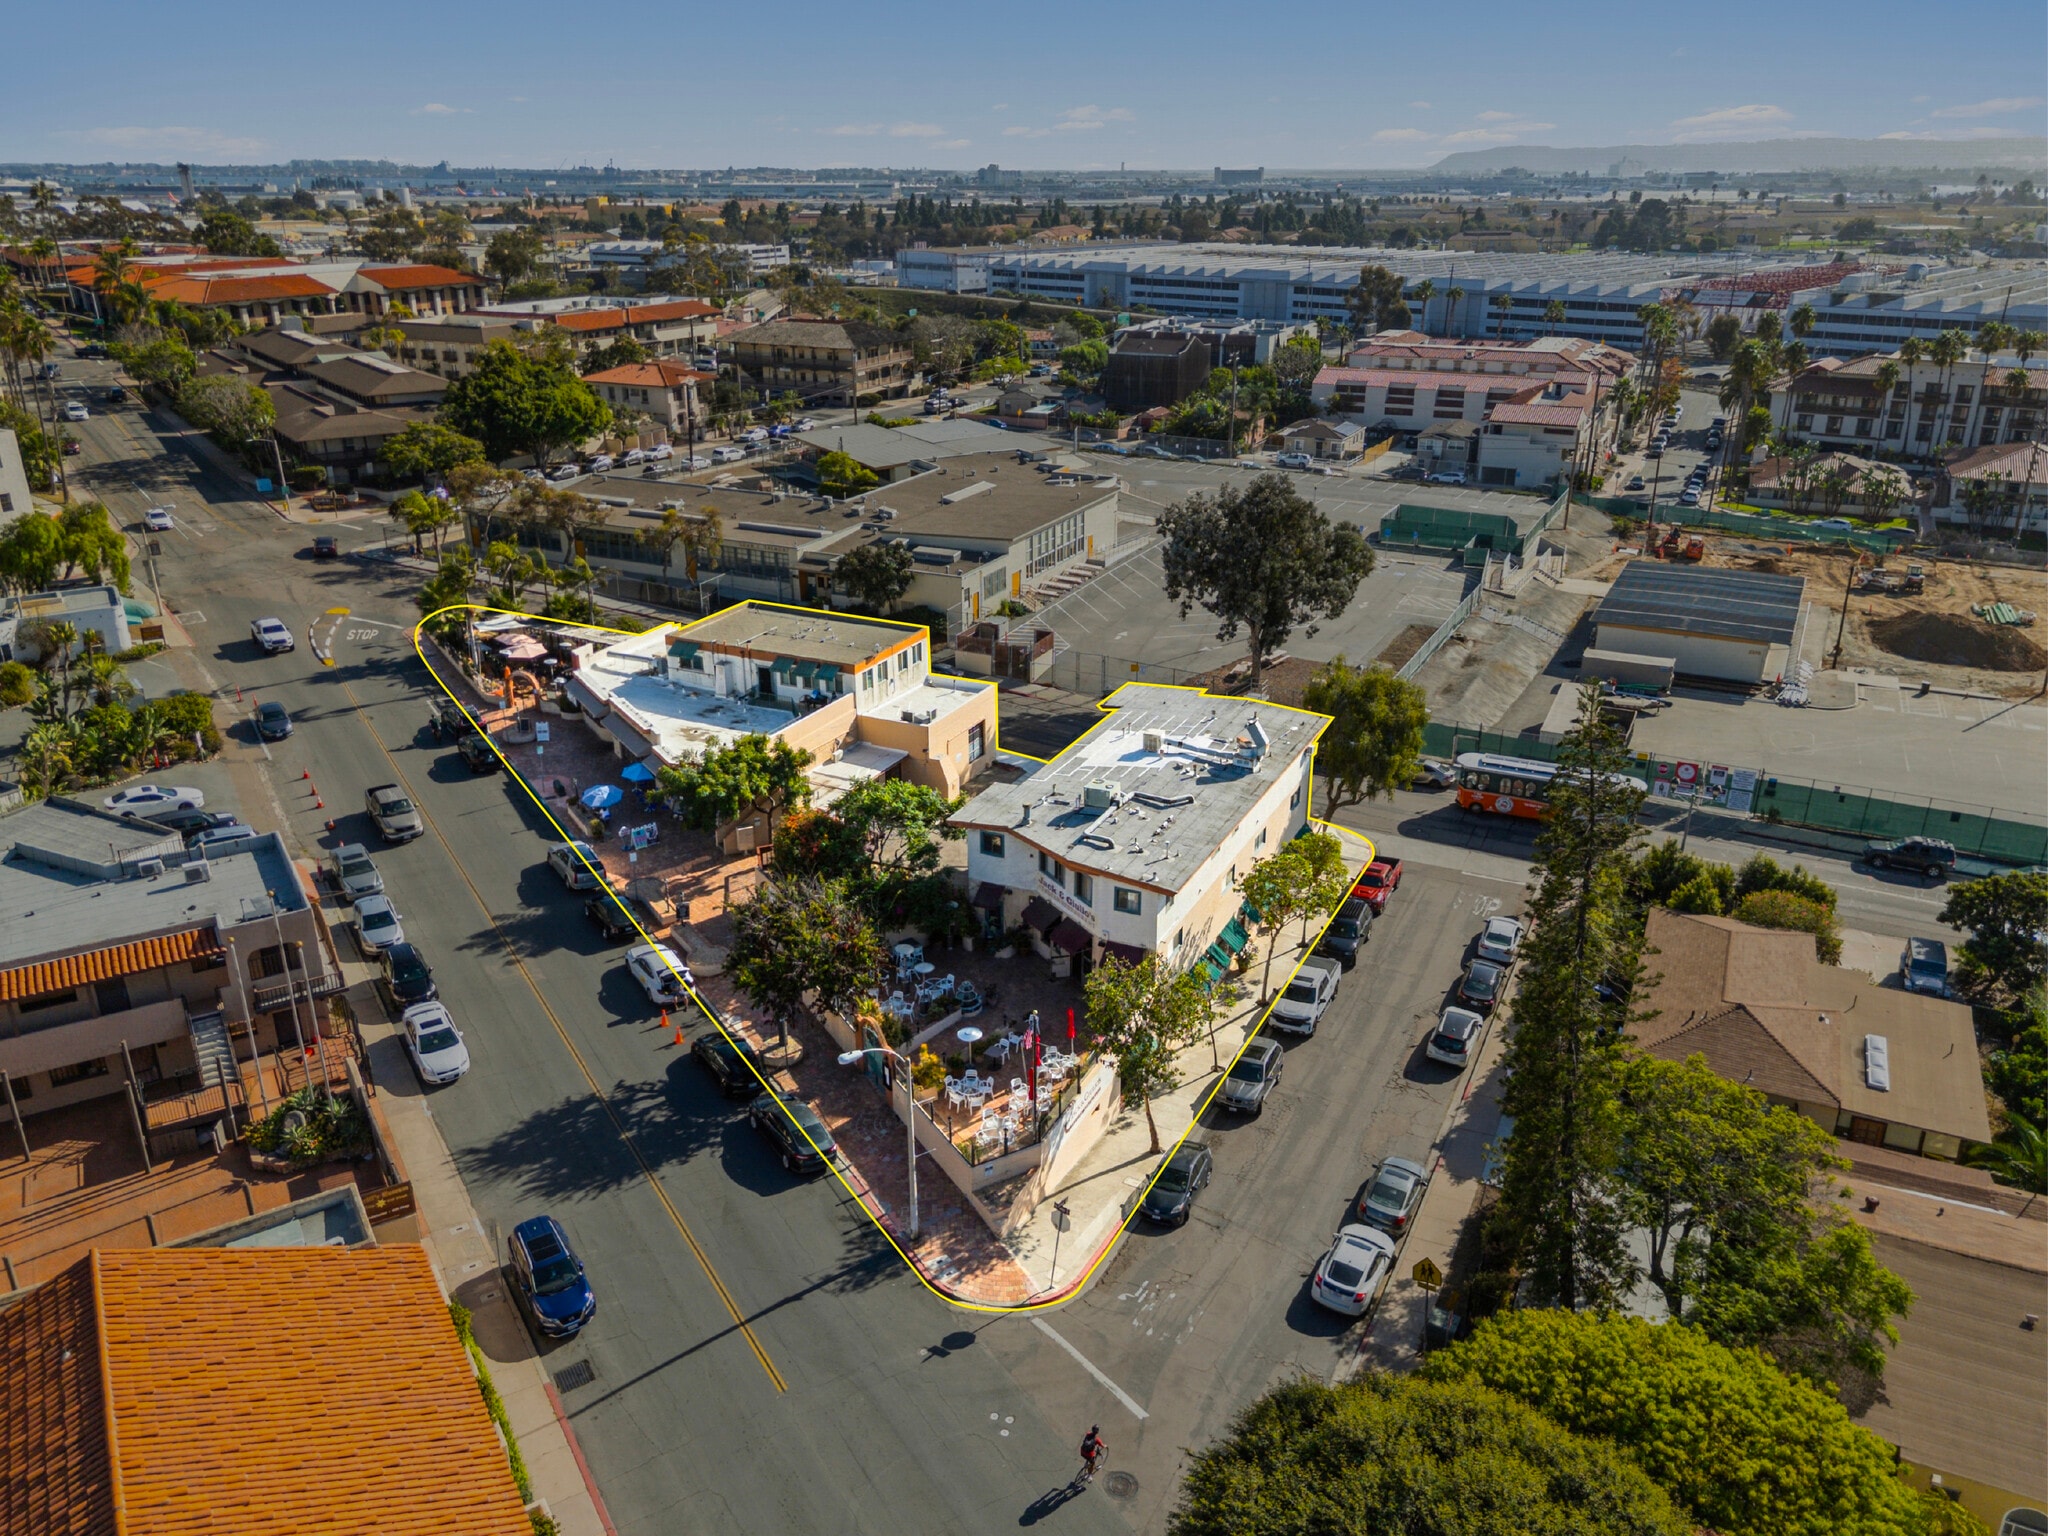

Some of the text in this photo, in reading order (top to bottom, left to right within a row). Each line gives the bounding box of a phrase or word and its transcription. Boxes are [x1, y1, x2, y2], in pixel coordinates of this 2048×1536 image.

[346, 629, 379, 640] STOP
[1038, 876, 1057, 895] Jack
[1066, 896, 1096, 922] Giulio's
